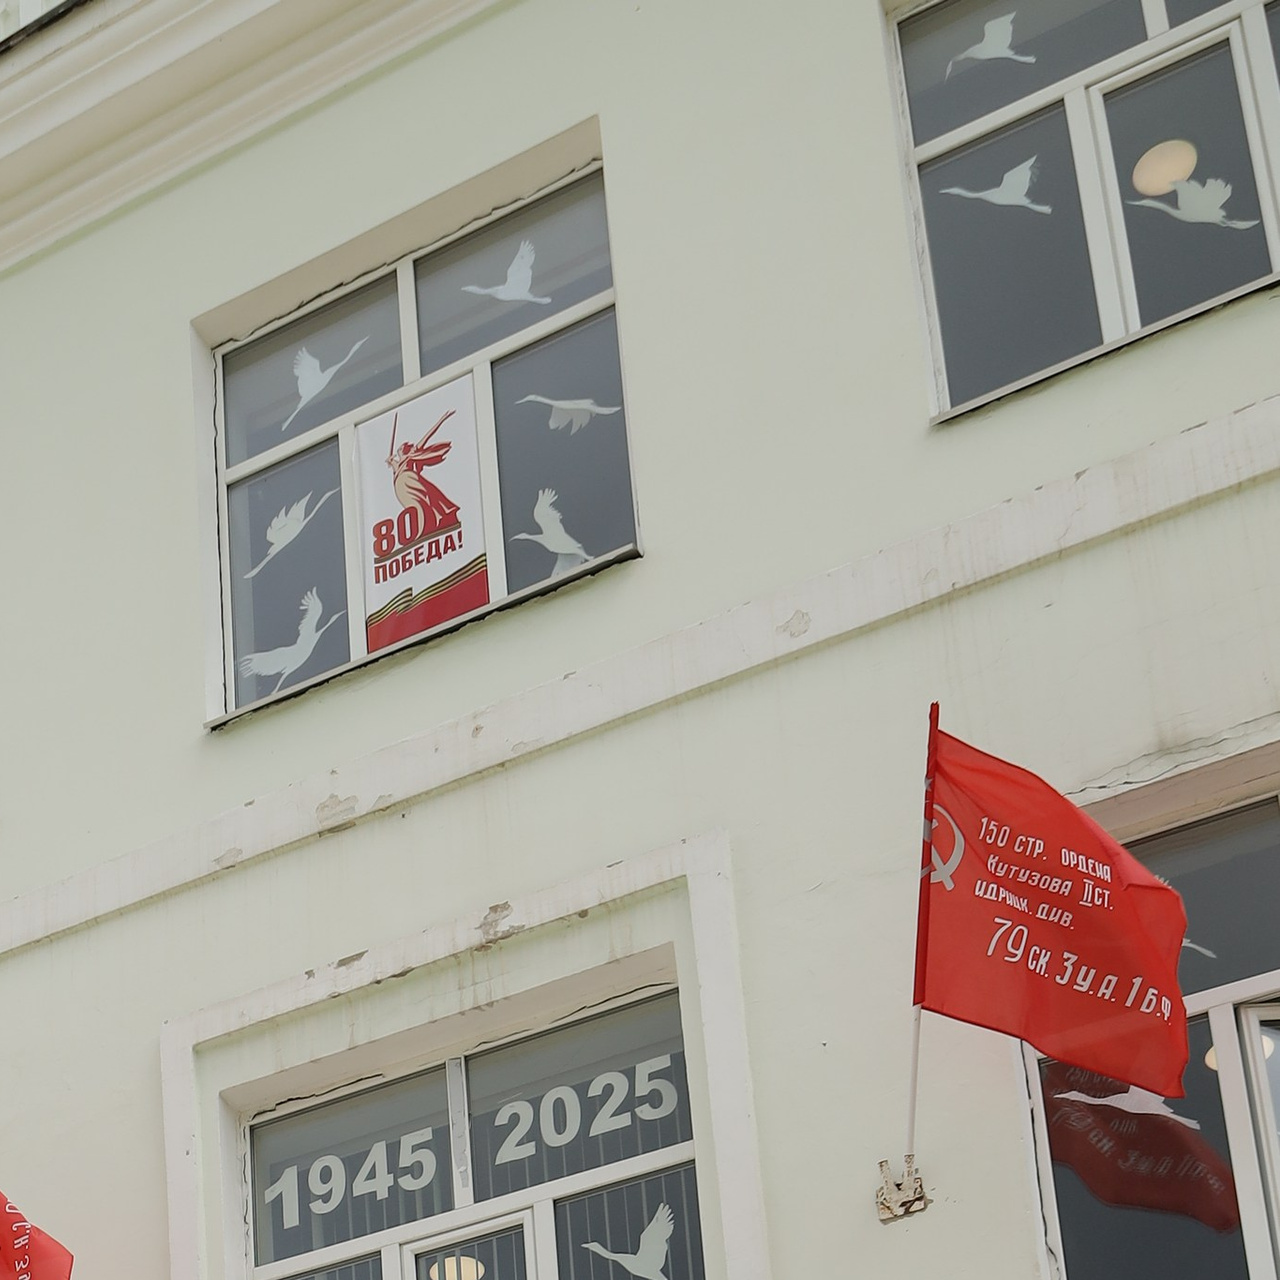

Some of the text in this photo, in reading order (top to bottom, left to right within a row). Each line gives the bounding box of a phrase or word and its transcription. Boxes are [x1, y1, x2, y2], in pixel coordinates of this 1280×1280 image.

[373, 505, 420, 559] 80
[374, 530, 463, 584] ПОБЕДА!
[978, 816, 1112, 883] 150 СТР. ОРДЕНА
[985, 916, 1030, 963] 79
[264, 1054, 678, 1230] 1945 2025
